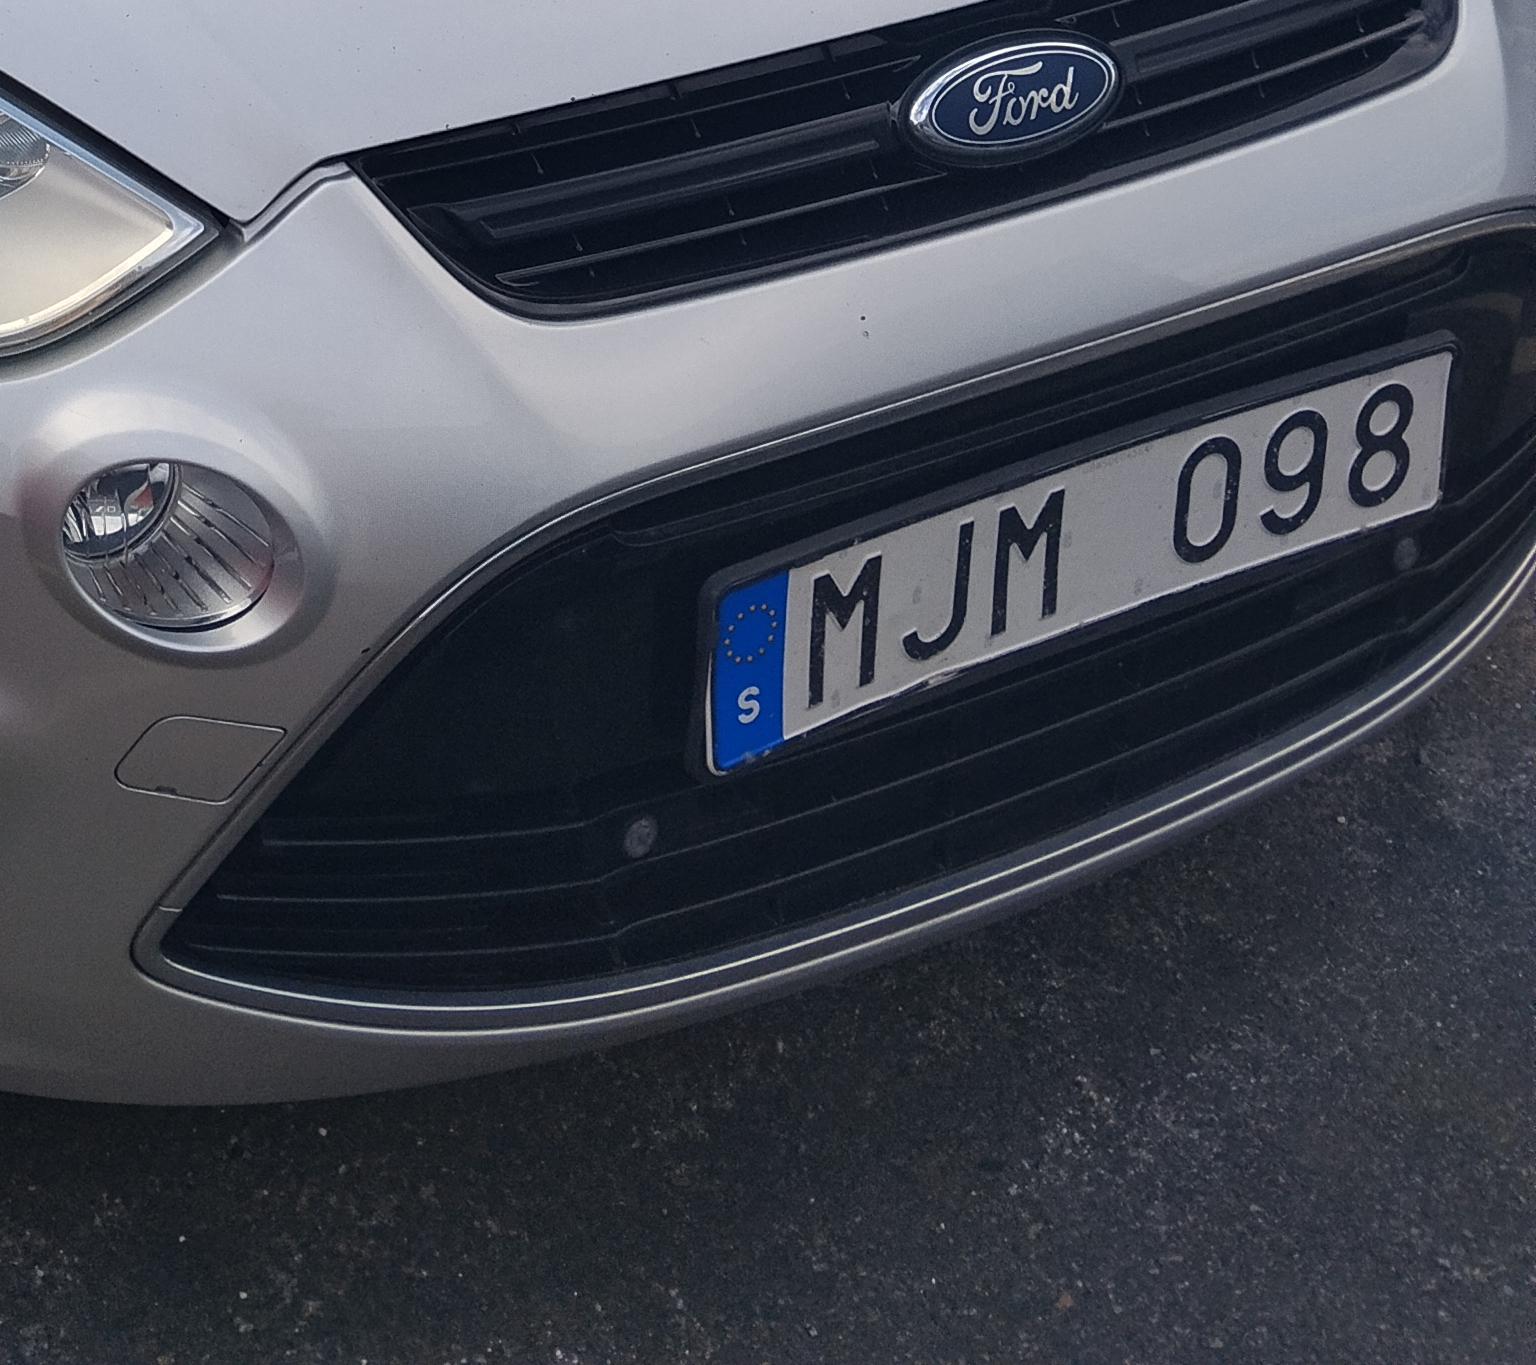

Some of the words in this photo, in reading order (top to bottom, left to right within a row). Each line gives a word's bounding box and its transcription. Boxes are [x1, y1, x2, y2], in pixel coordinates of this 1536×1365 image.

[969, 61, 1079, 136] Ford
[806, 487, 1065, 710] MJM
[1173, 382, 1415, 563] 098
[736, 686, 761, 724] S
